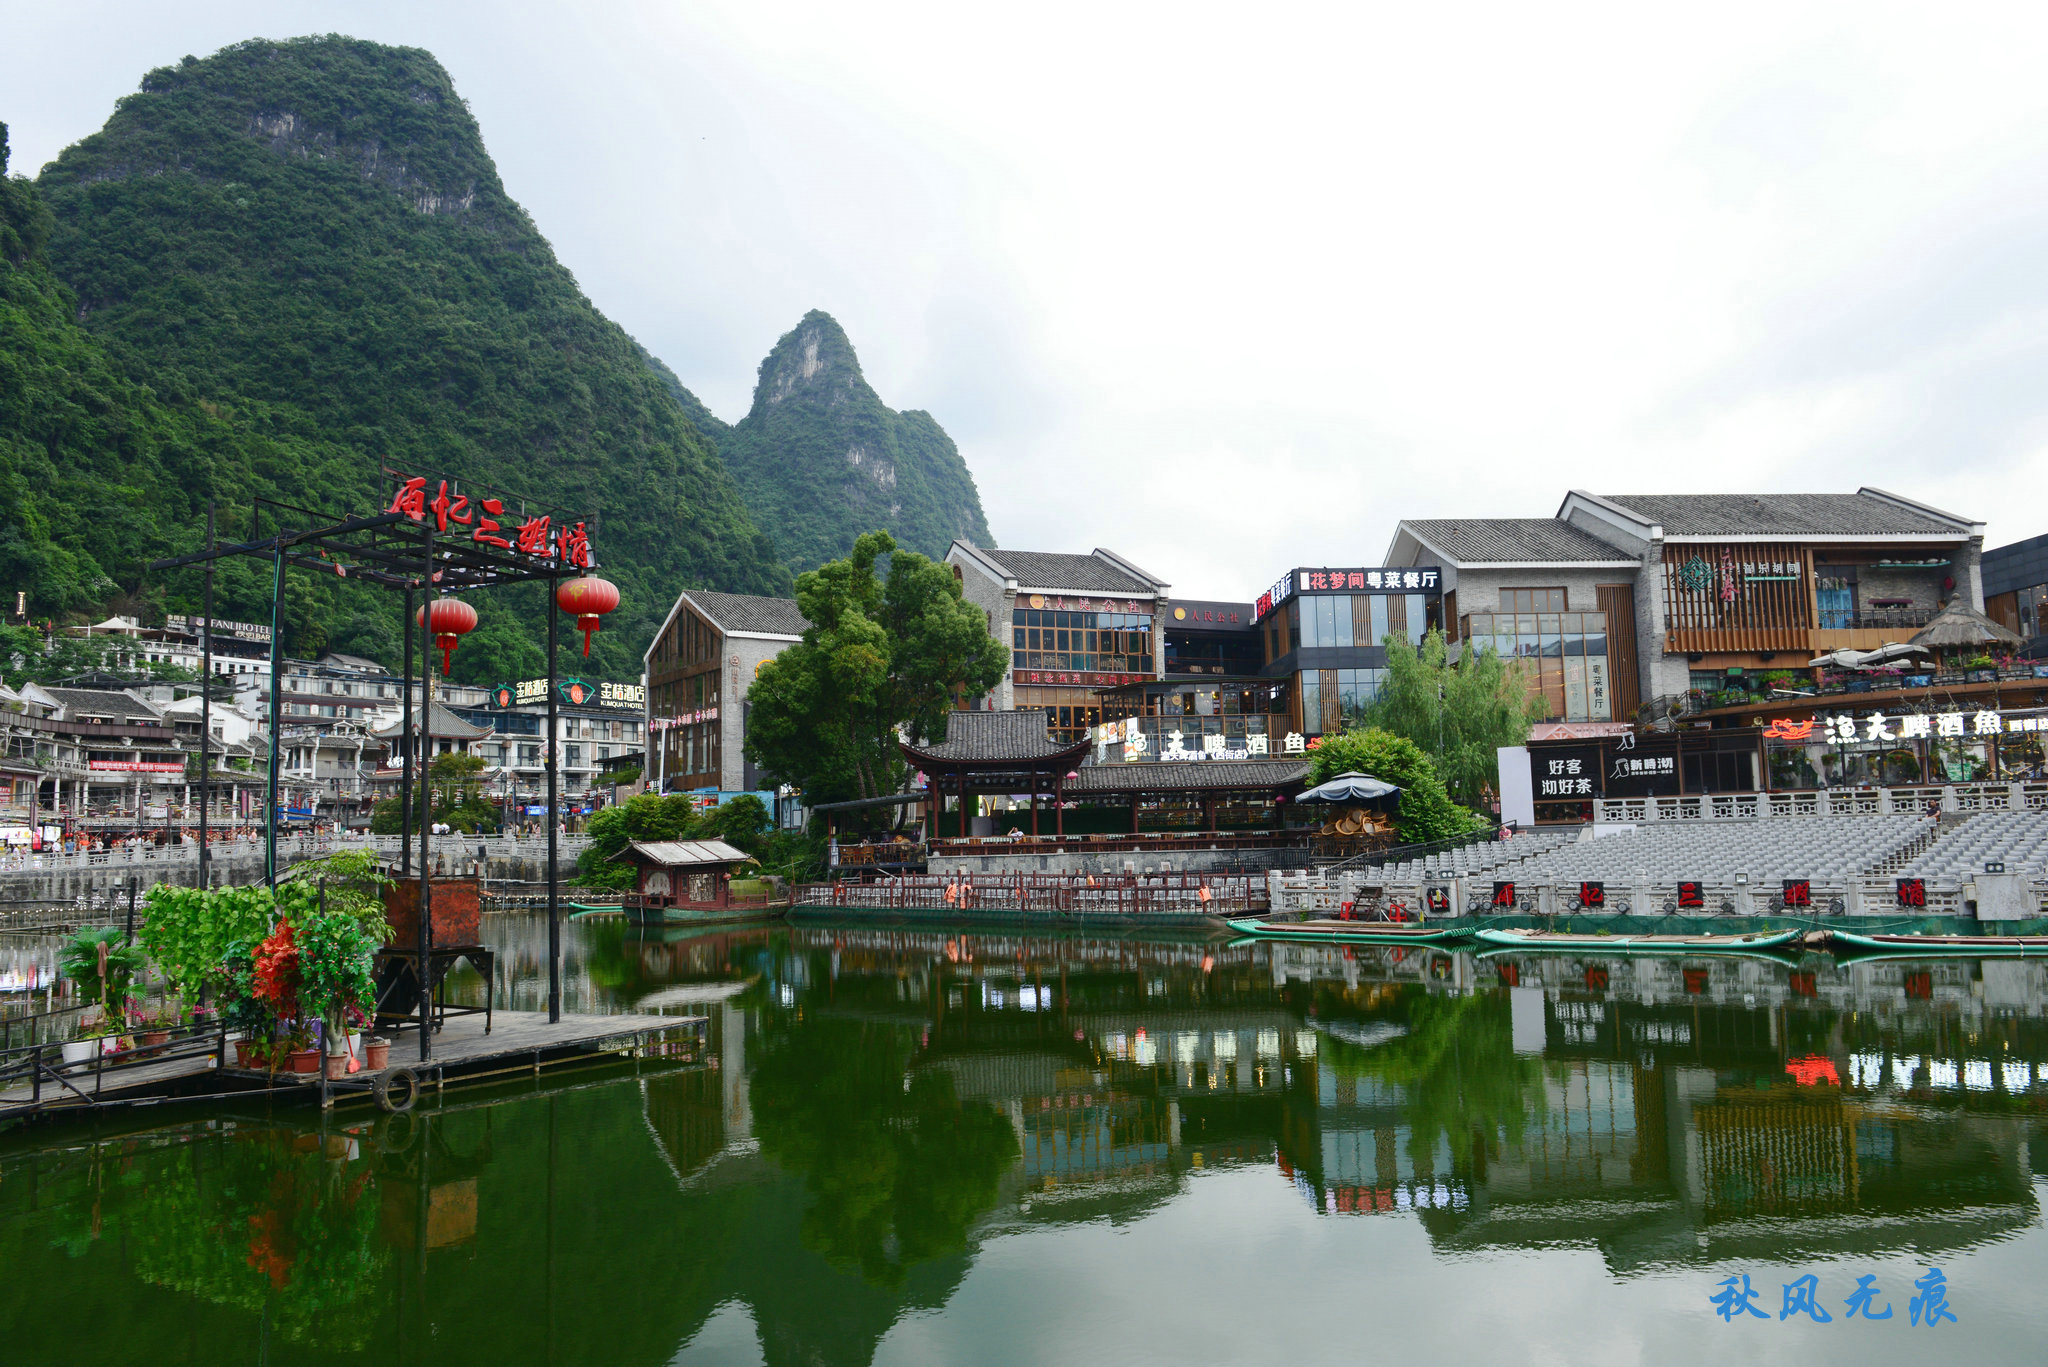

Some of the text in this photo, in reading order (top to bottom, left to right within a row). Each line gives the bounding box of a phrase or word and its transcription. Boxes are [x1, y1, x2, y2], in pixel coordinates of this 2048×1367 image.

[1310, 572, 1438, 590] 花梦间粤菜餐厅
[1054, 596, 1140, 614] 人民公社
[1192, 609, 1240, 623] 人民公社
[516, 679, 549, 698] 金桔酒店
[600, 682, 645, 702] 金桔酒店
[1549, 759, 1582, 775] 好客
[1542, 779, 1592, 795] 沏好茶
